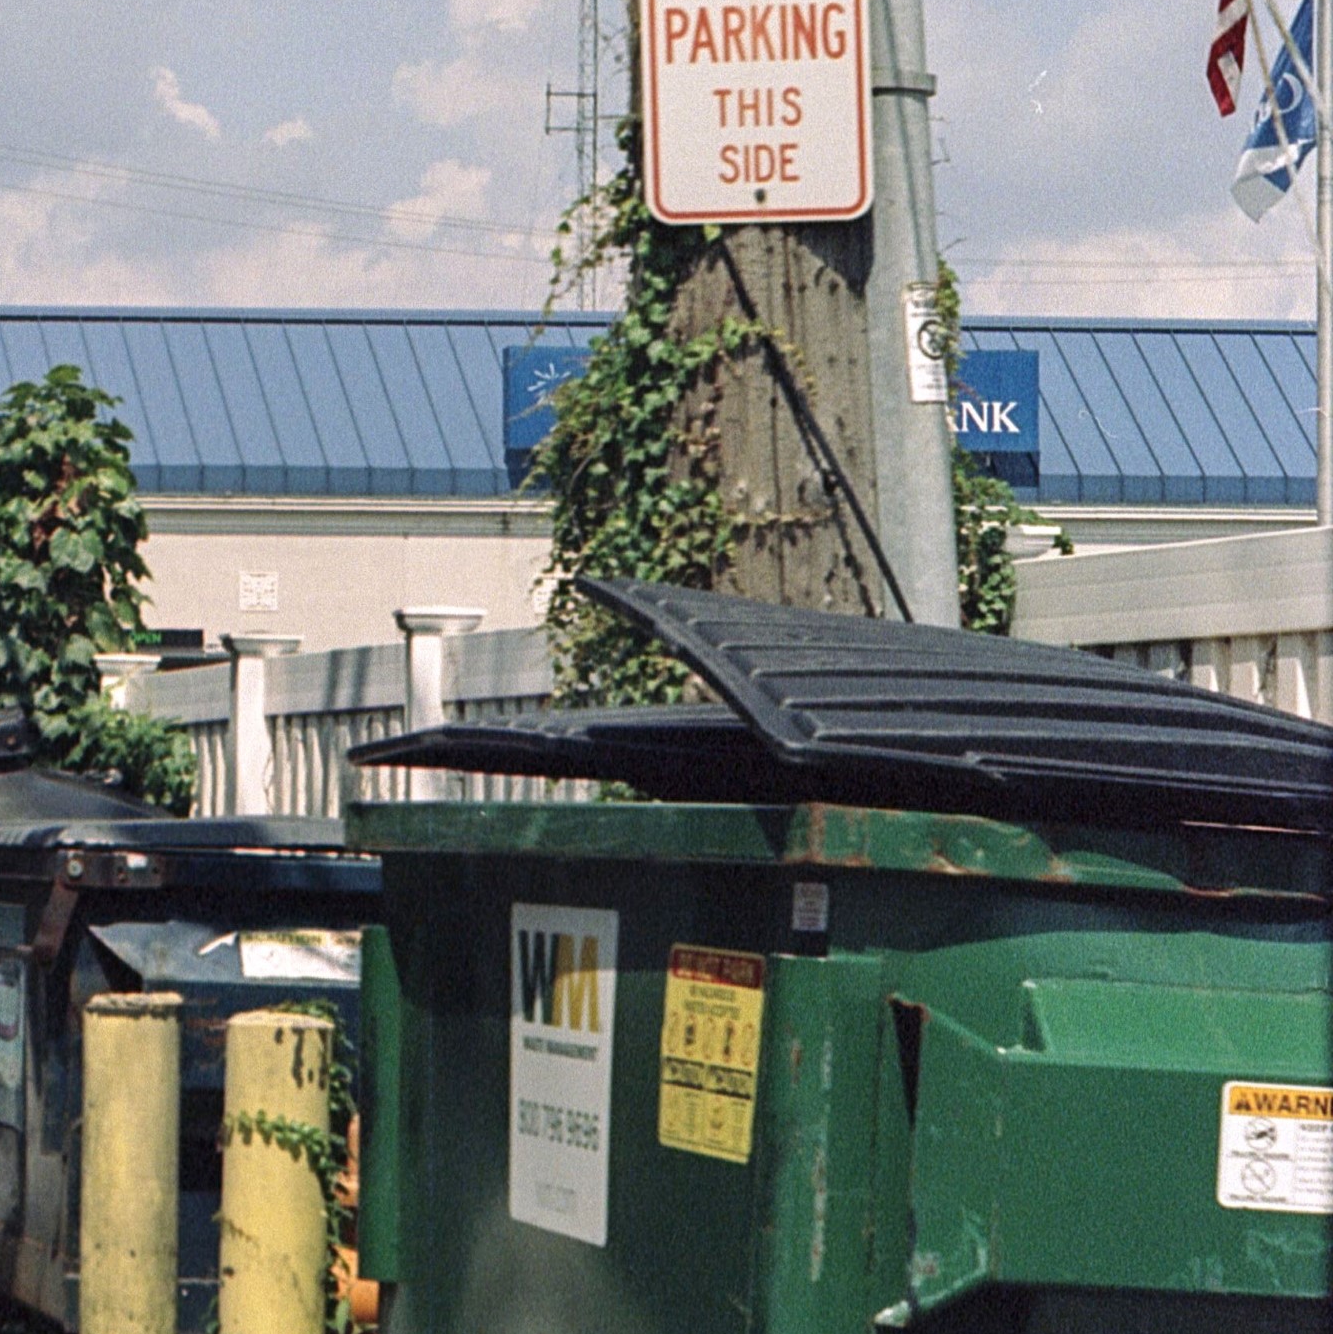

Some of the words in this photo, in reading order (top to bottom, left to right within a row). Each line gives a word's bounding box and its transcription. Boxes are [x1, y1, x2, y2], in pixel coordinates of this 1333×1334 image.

[664, 3, 847, 64] PARKING
[713, 87, 802, 127] THIS
[719, 144, 800, 184] SIDE
[945, 401, 1021, 433] NK
[518, 930, 599, 1033] WM
